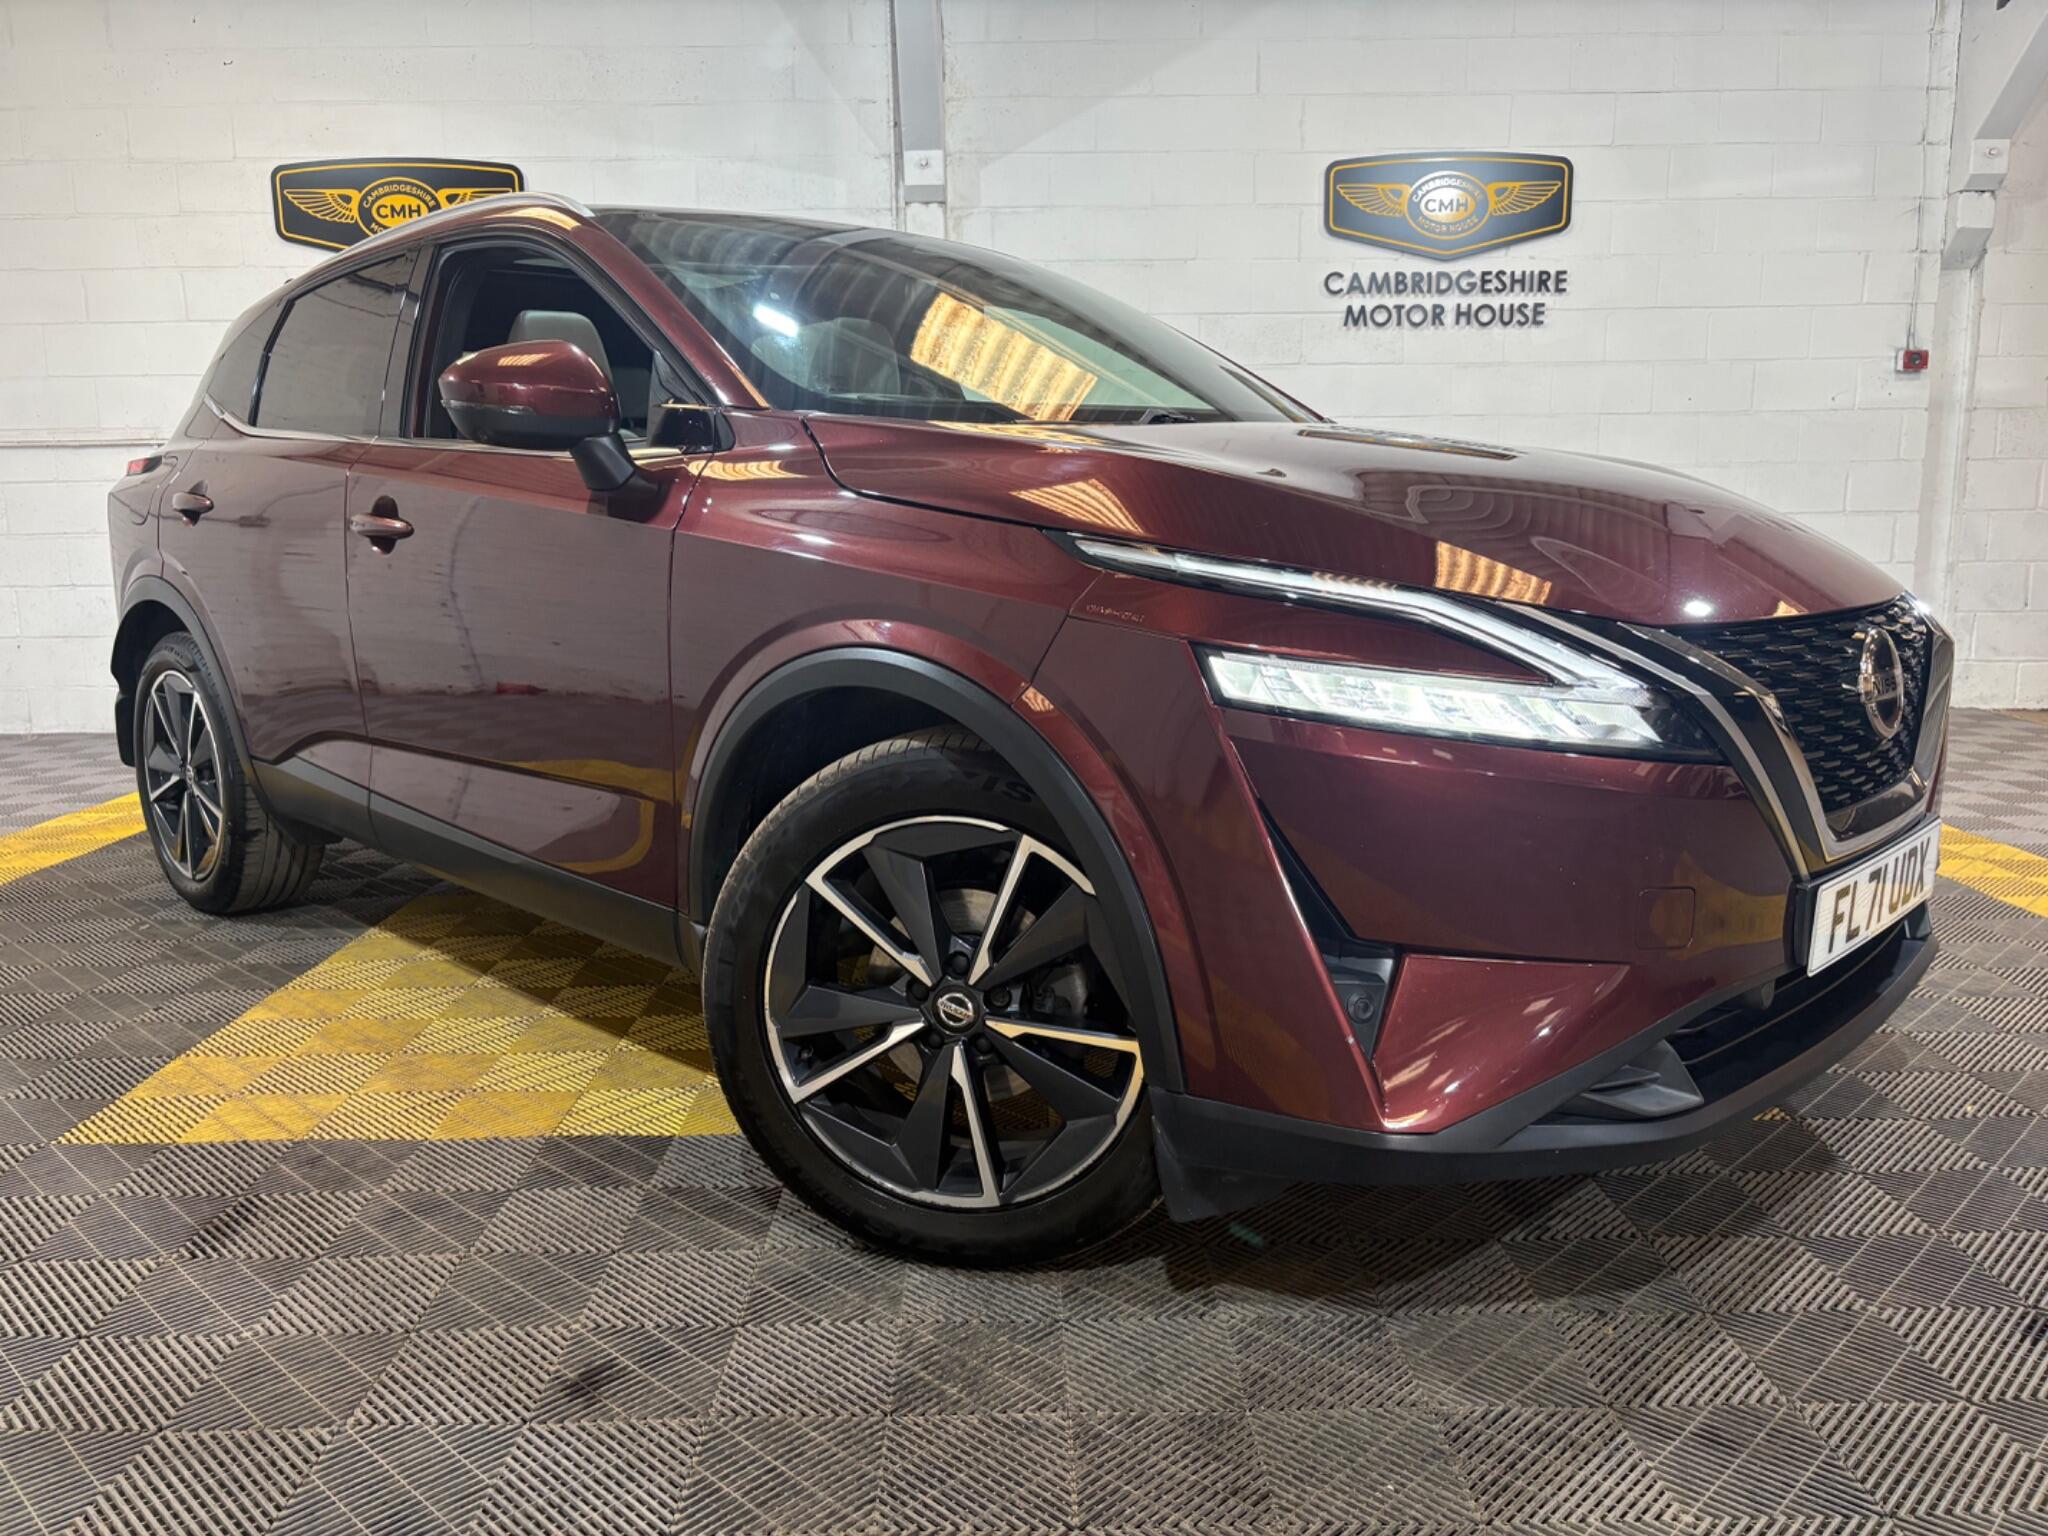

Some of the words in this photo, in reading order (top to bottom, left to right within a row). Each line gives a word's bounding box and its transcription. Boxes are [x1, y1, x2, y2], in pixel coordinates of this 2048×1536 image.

[363, 184, 436, 208] CAMBRIDGESHIRE
[1424, 198, 1468, 212] CMH
[376, 204, 421, 219] CMH
[1324, 270, 1568, 295] CAMBRIDGESHIRE
[1343, 304, 1445, 327] MOTOR
[1455, 303, 1545, 326] HOUSE
